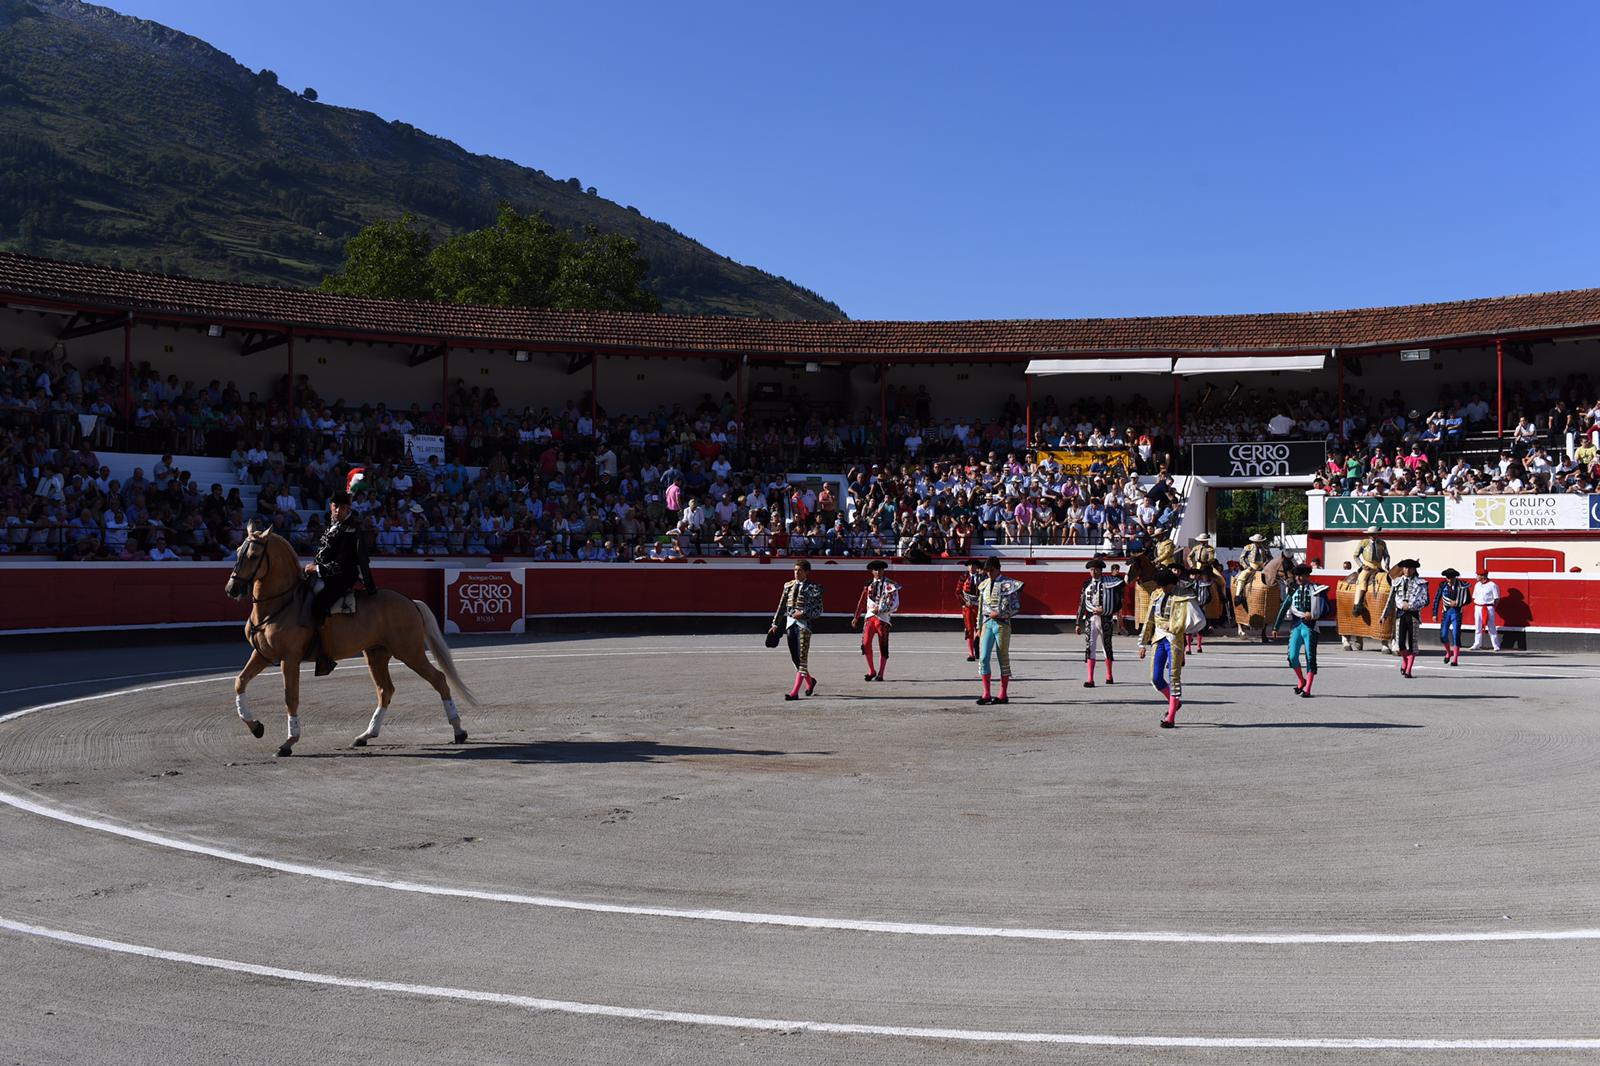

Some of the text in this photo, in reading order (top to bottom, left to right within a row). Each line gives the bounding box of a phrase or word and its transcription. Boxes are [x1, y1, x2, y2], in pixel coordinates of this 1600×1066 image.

[1229, 444, 1290, 460] CERRO
[1509, 497, 1556, 507] GRUPO
[1331, 499, 1440, 524] AÑARES
[1509, 517, 1555, 526] OLARRA
[458, 583, 512, 599] CERRO
